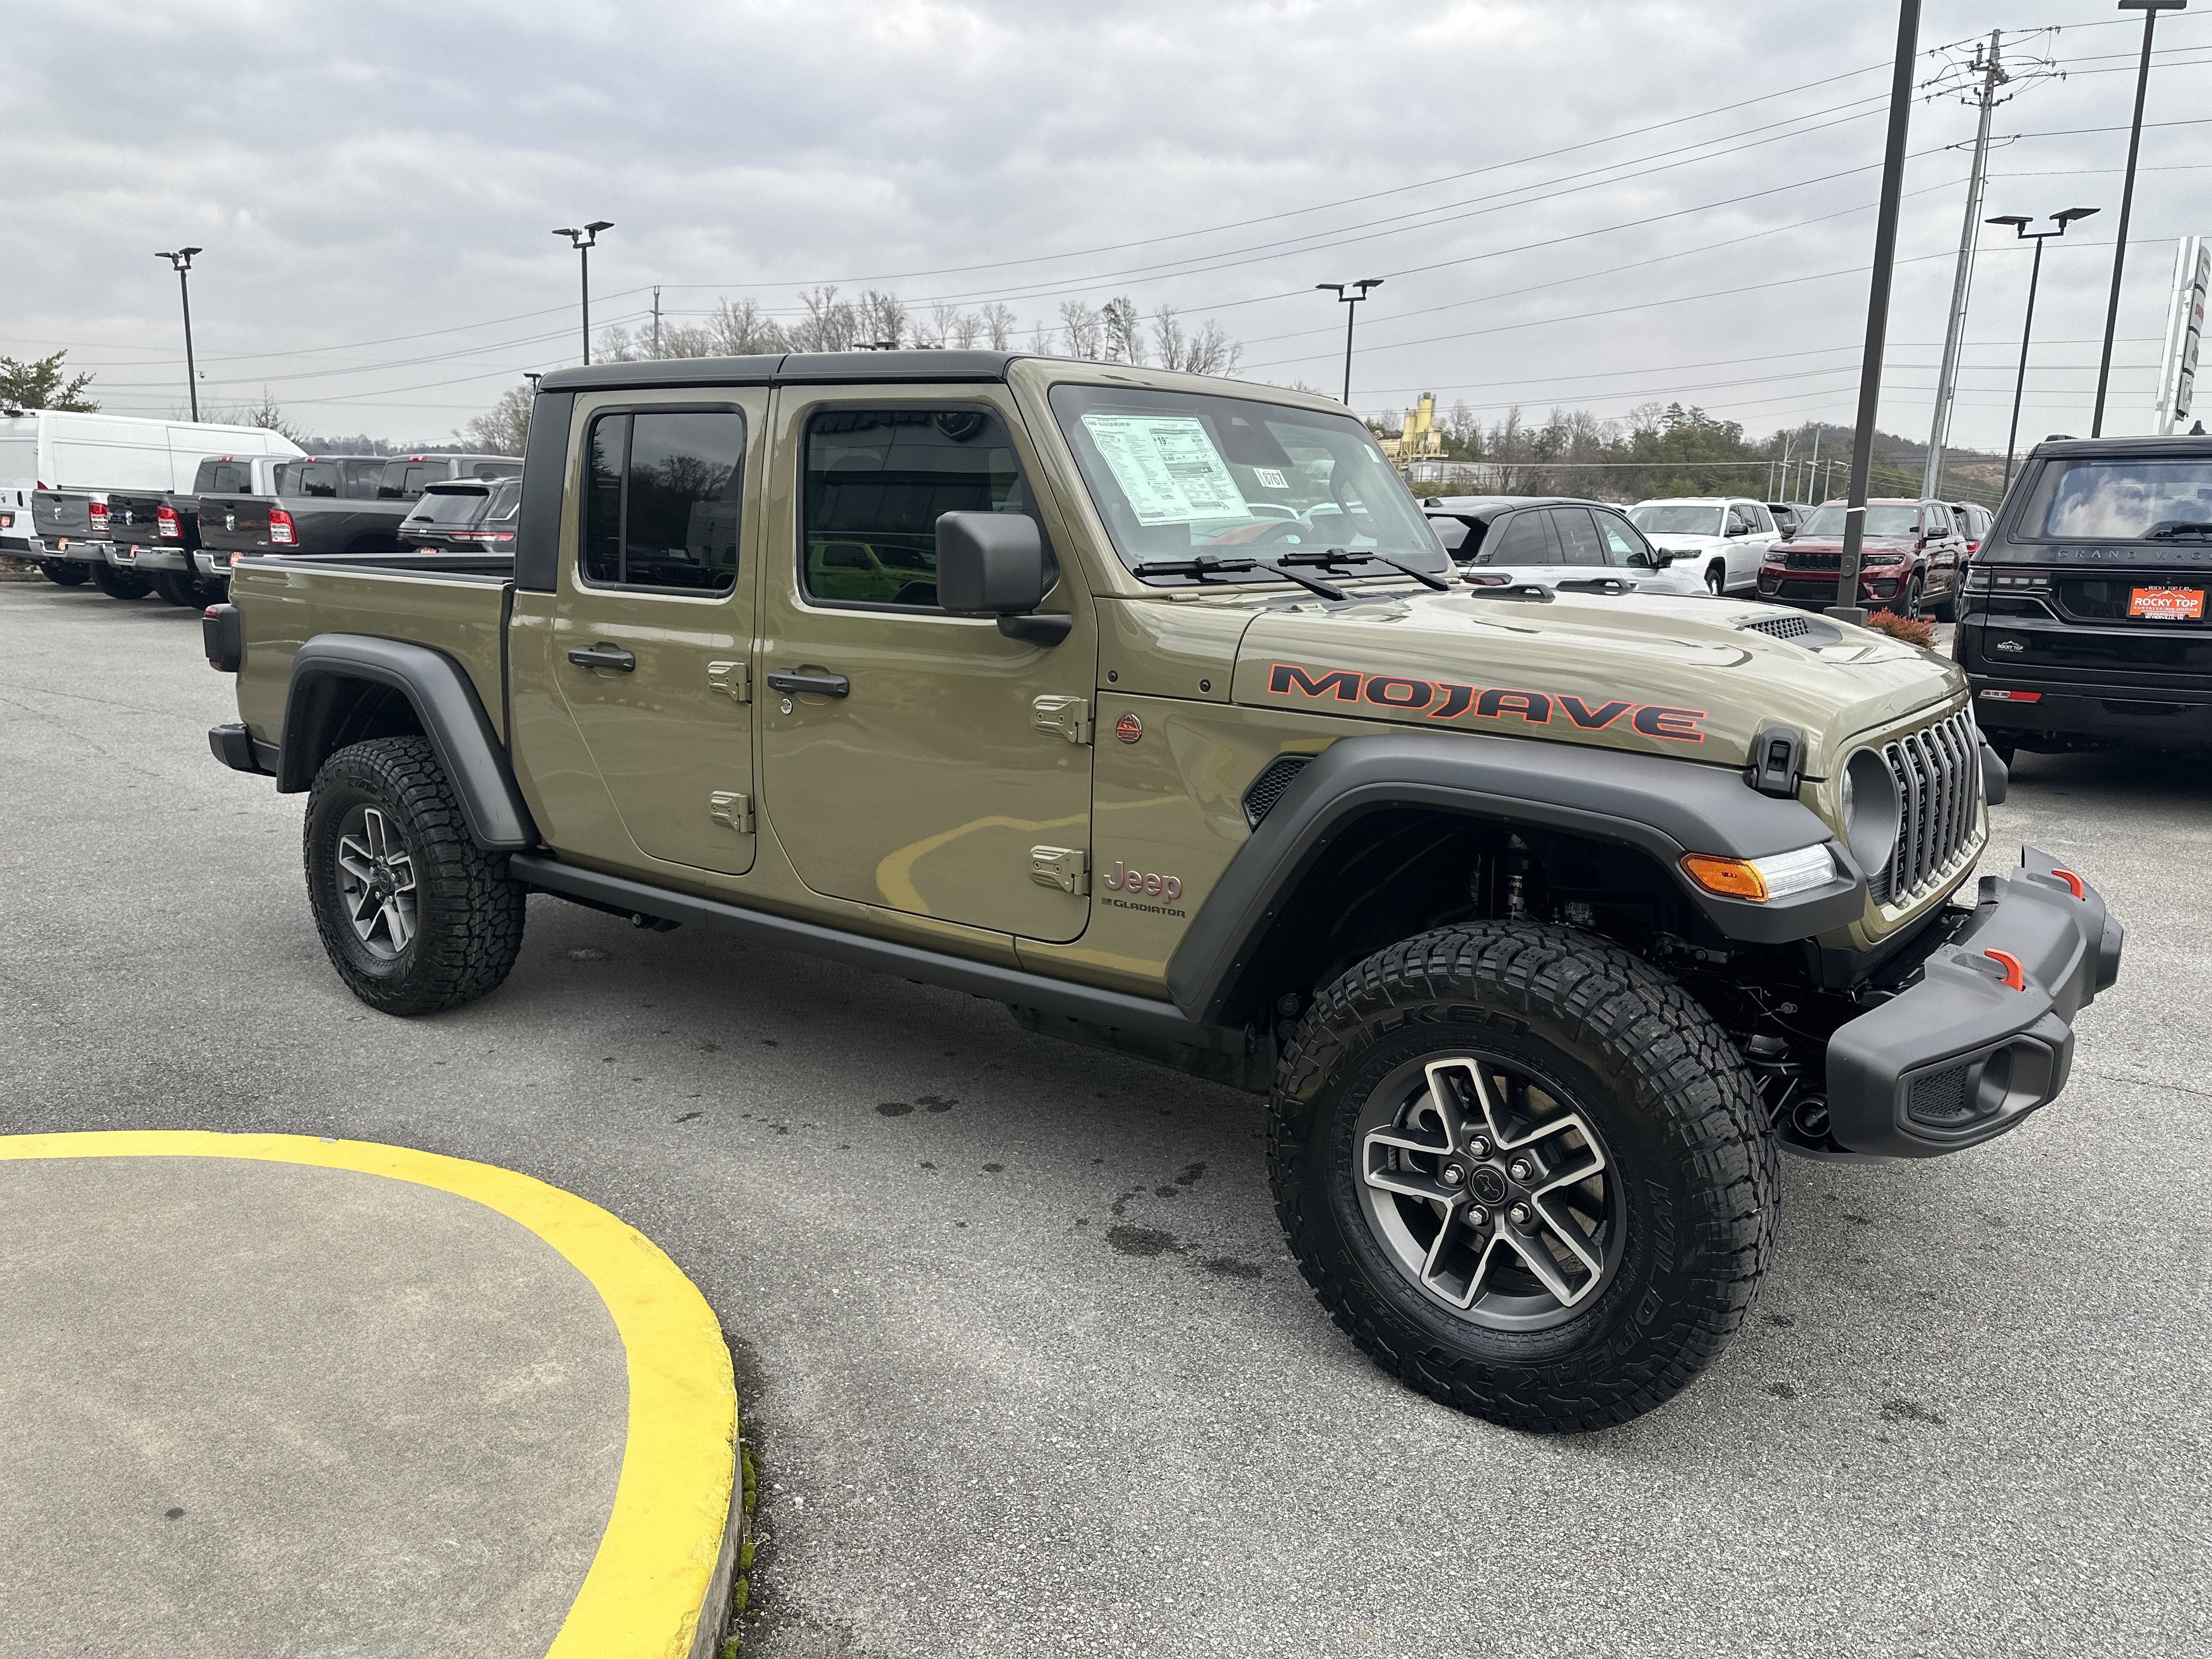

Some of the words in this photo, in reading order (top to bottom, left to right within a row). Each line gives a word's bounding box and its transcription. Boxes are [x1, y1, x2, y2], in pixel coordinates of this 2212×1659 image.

[1158, 437, 1166, 445] 19
[1262, 472, 1284, 486] 8767
[2058, 550, 2136, 559] GRAND
[2135, 598, 2172, 607] ROCKY
[2175, 599, 2199, 607] TOP
[1267, 663, 1708, 744] MOJAVE
[1104, 861, 1183, 905] Jeep
[1114, 899, 1186, 918] GLADIATOR
